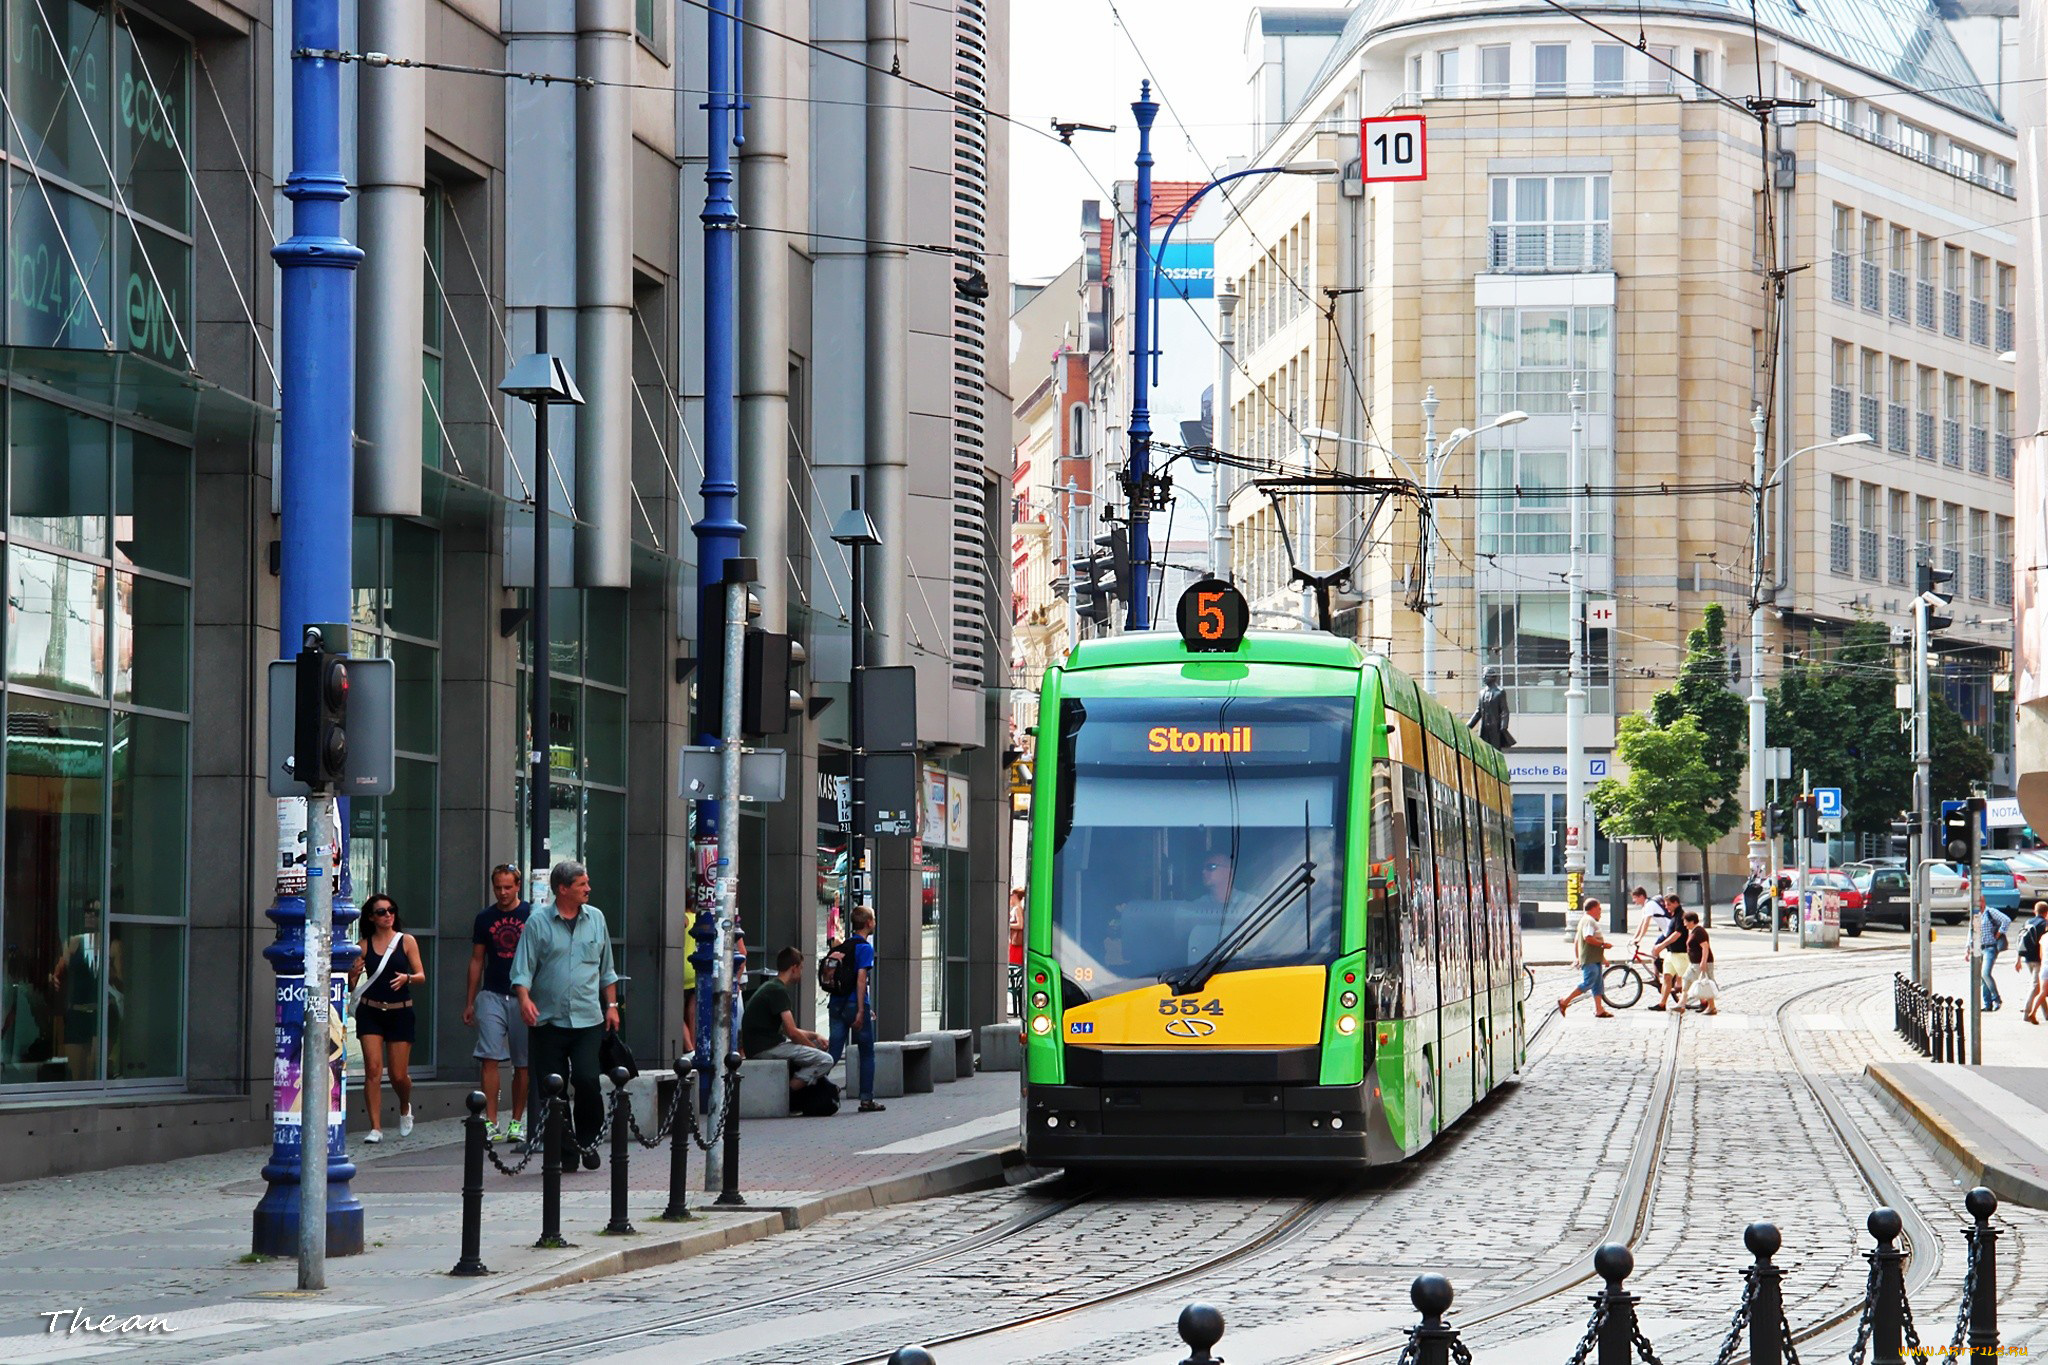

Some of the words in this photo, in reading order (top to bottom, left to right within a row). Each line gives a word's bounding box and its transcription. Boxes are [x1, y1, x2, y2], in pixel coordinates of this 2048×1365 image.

[121, 72, 176, 149] ecco
[1373, 132, 1413, 165] 10
[1198, 591, 1225, 639] 5
[1148, 726, 1252, 753] Stomil
[1508, 765, 1549, 776] utsche
[842, 789, 847, 799] 5
[1819, 791, 1835, 815] P
[841, 811, 849, 820] 16
[1754, 811, 1762, 841] KARINA
[1158, 998, 1224, 1016] 554
